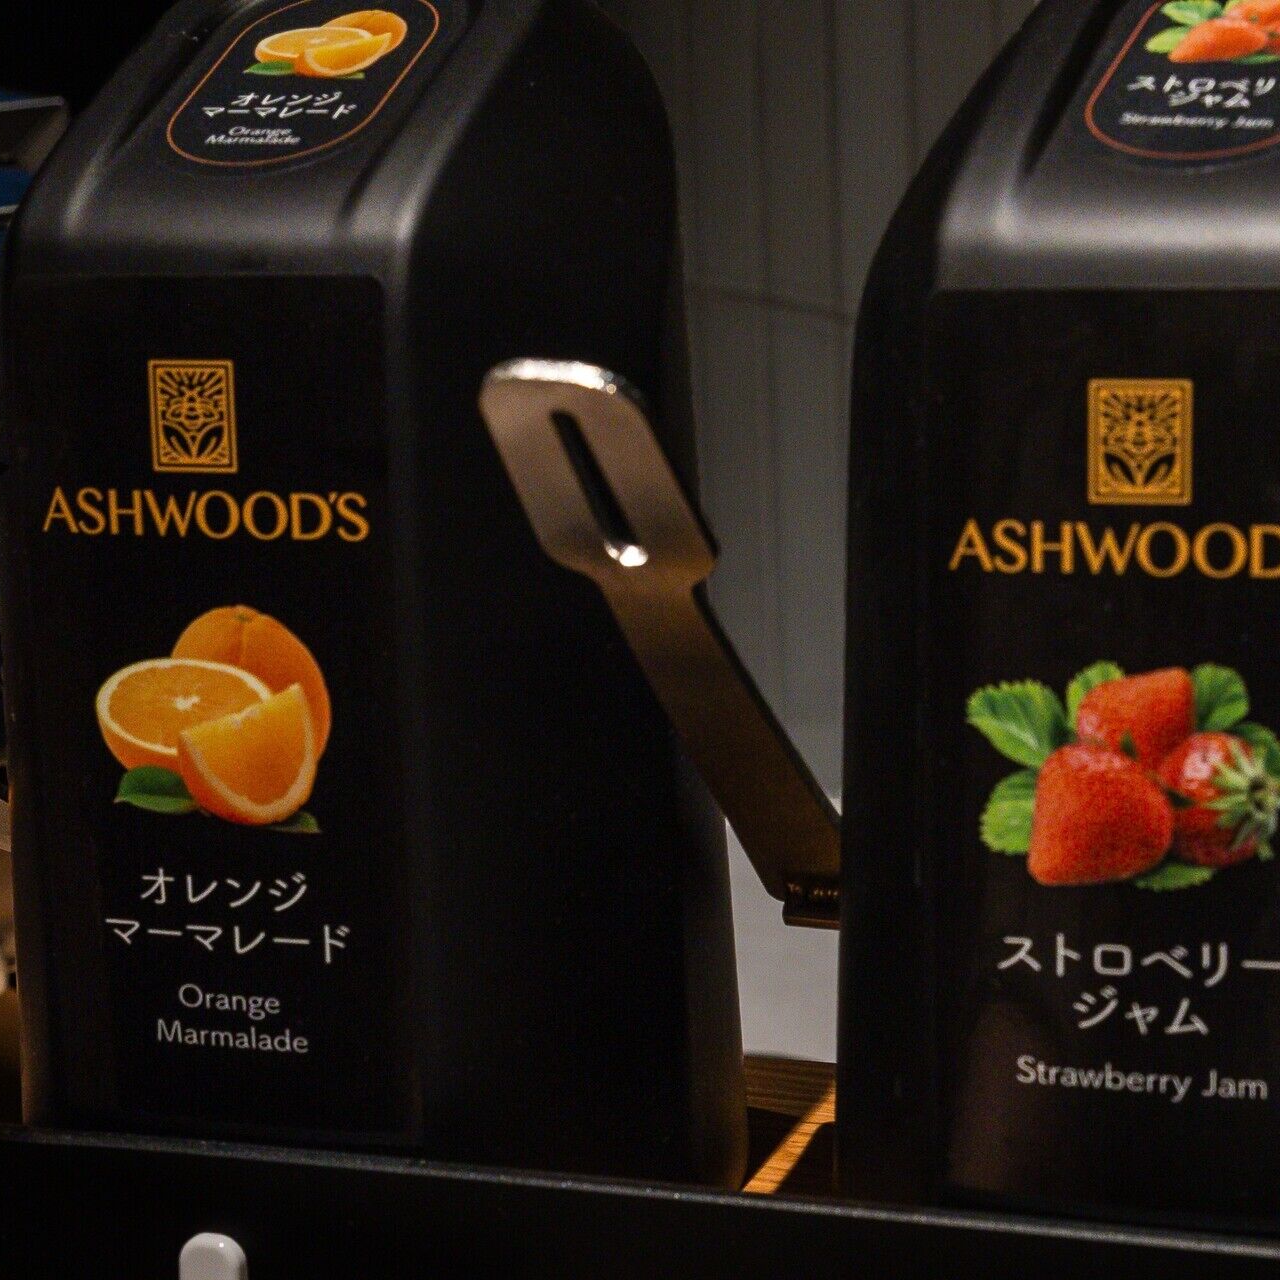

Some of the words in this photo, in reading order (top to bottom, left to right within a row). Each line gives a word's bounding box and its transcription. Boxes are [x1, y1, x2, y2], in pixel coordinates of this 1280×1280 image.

[201, 103, 358, 120] マーマレード
[230, 90, 343, 107] オレンジ
[43, 486, 370, 543] ASHWOOD'S
[140, 867, 308, 912] オレンジ
[105, 918, 351, 965] マーマレード
[178, 983, 281, 1020] Orange
[1072, 985, 1209, 1035] ジャム
[157, 1018, 309, 1054] Marmalade
[1016, 1054, 1193, 1103] Strawberry
[1201, 1068, 1269, 1100] Jam
